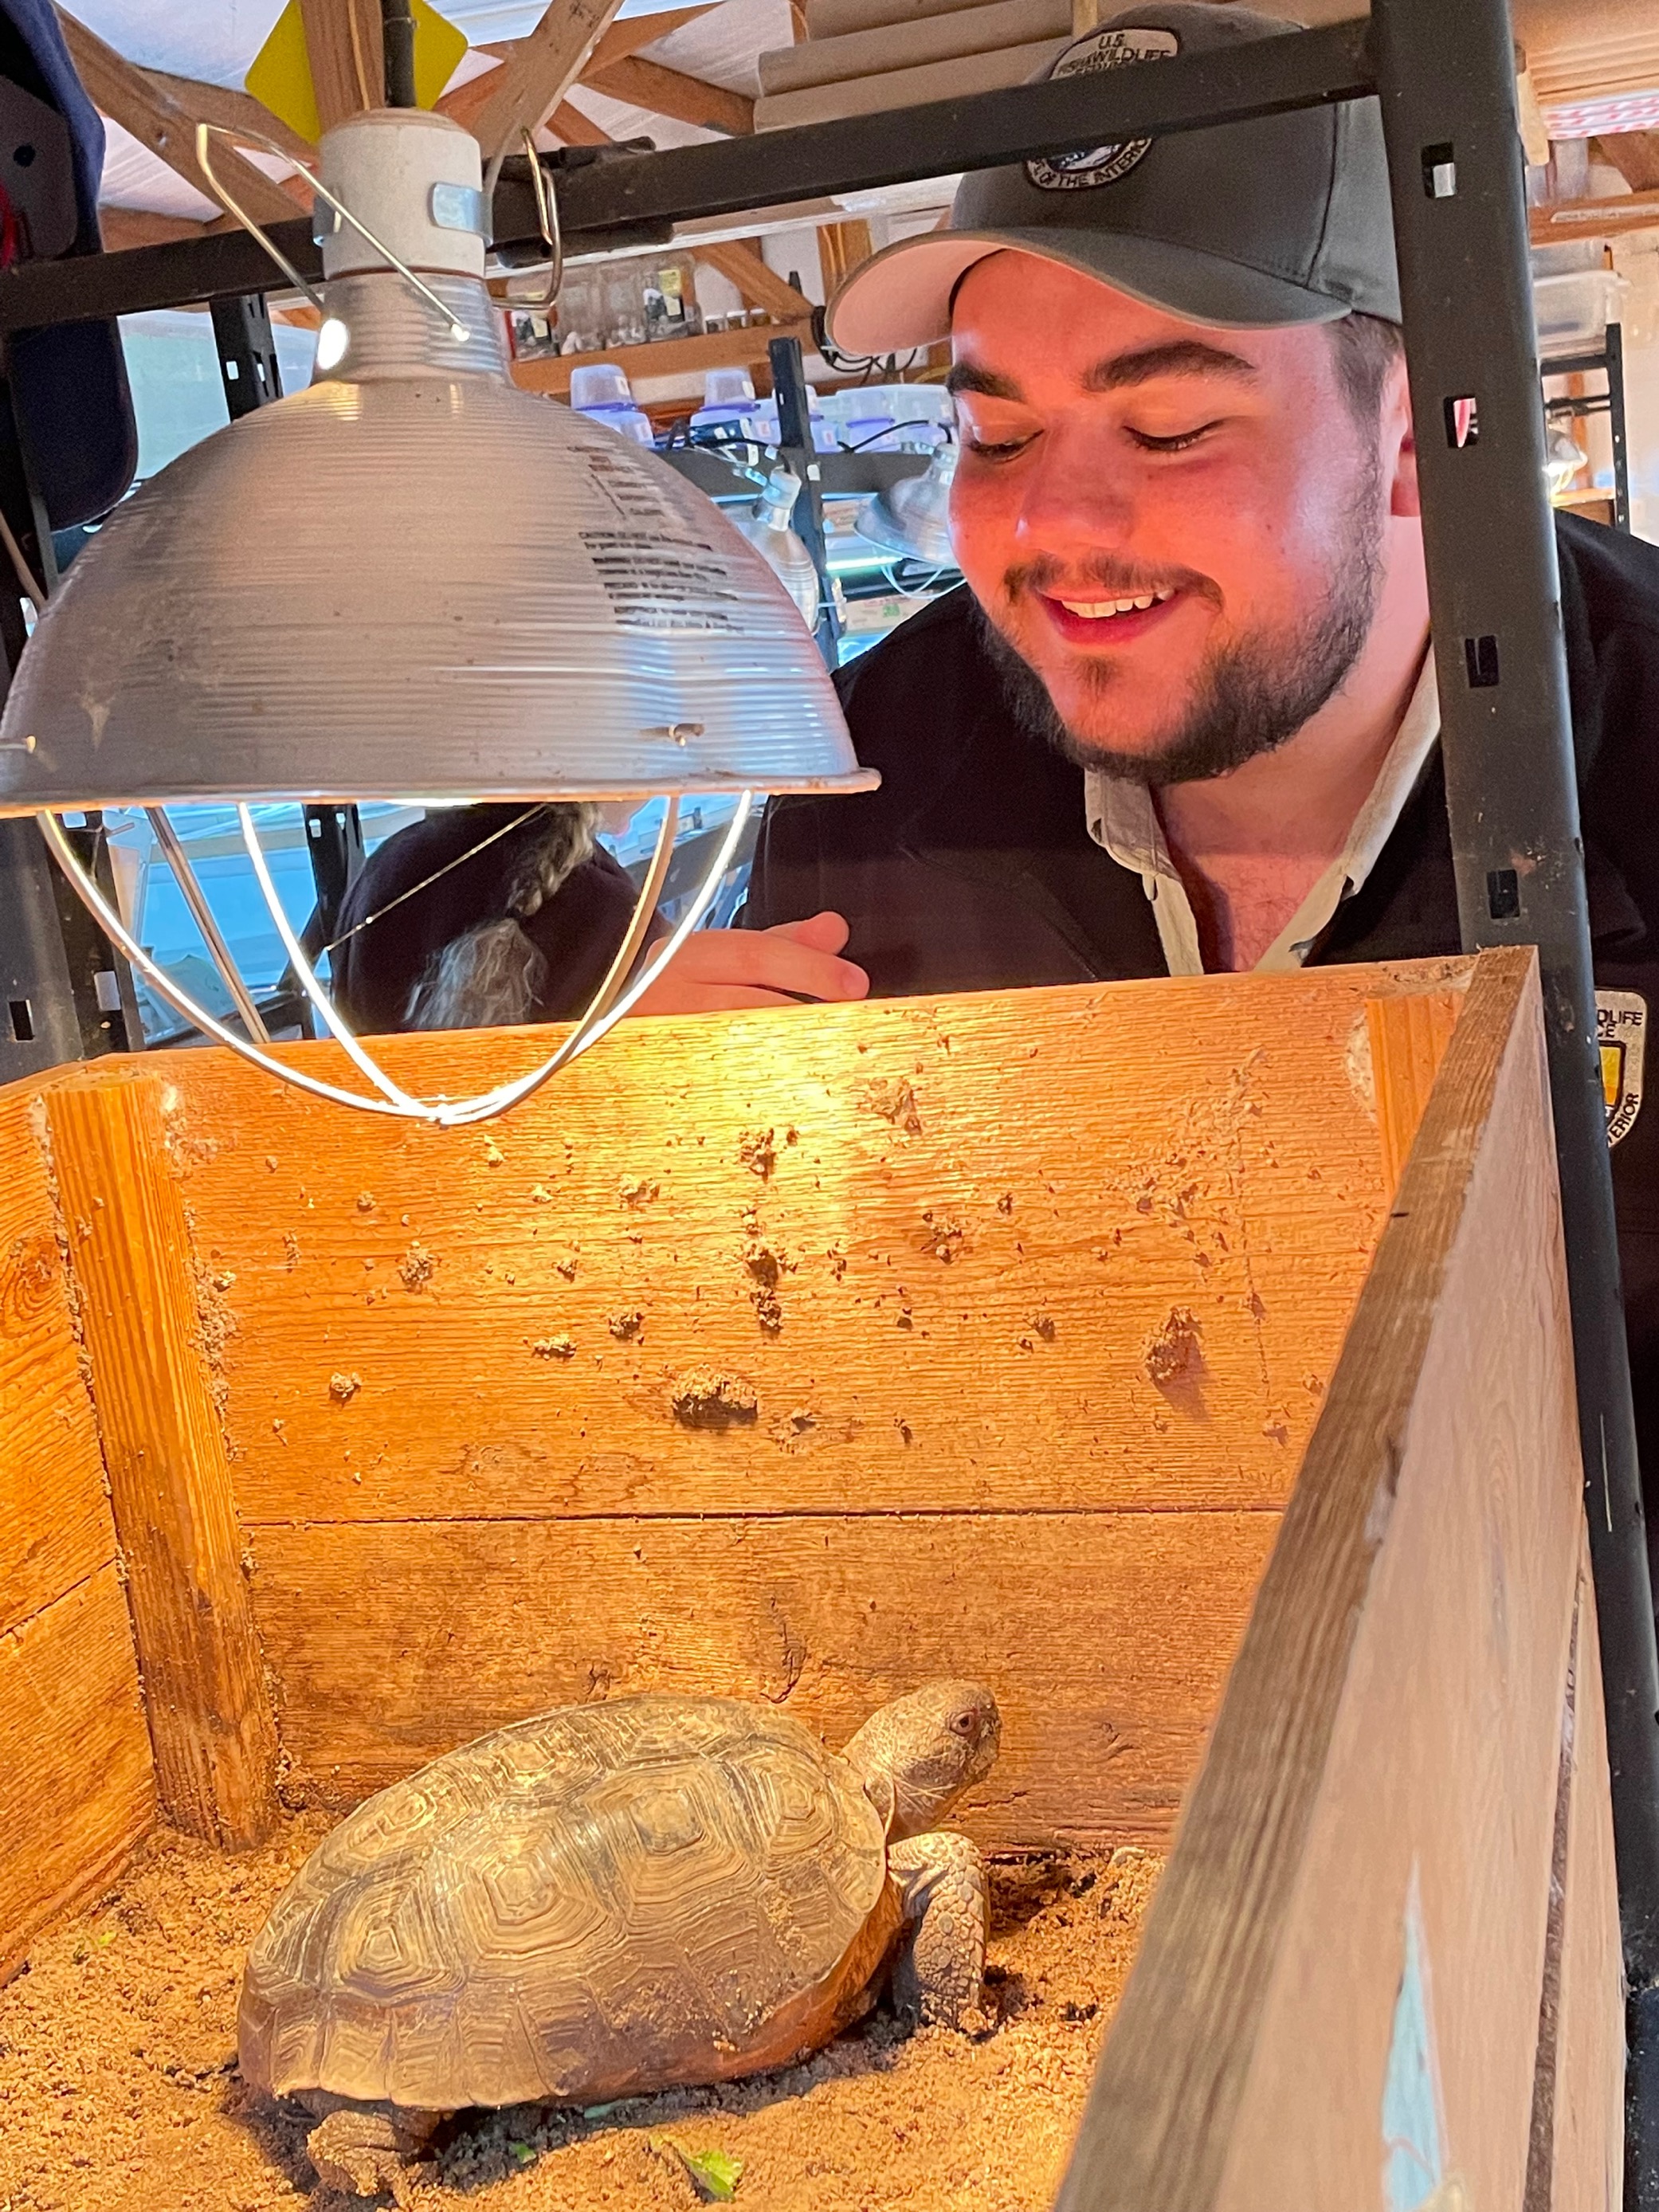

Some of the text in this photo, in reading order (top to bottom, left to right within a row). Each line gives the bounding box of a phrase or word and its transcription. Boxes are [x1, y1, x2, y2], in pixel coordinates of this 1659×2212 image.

[1058, 173, 1089, 186] THE
[1093, 138, 1147, 184] INTERIO
[1597, 1009, 1643, 1026] DLIFE
[1608, 1092, 1639, 1143] ERIOR
